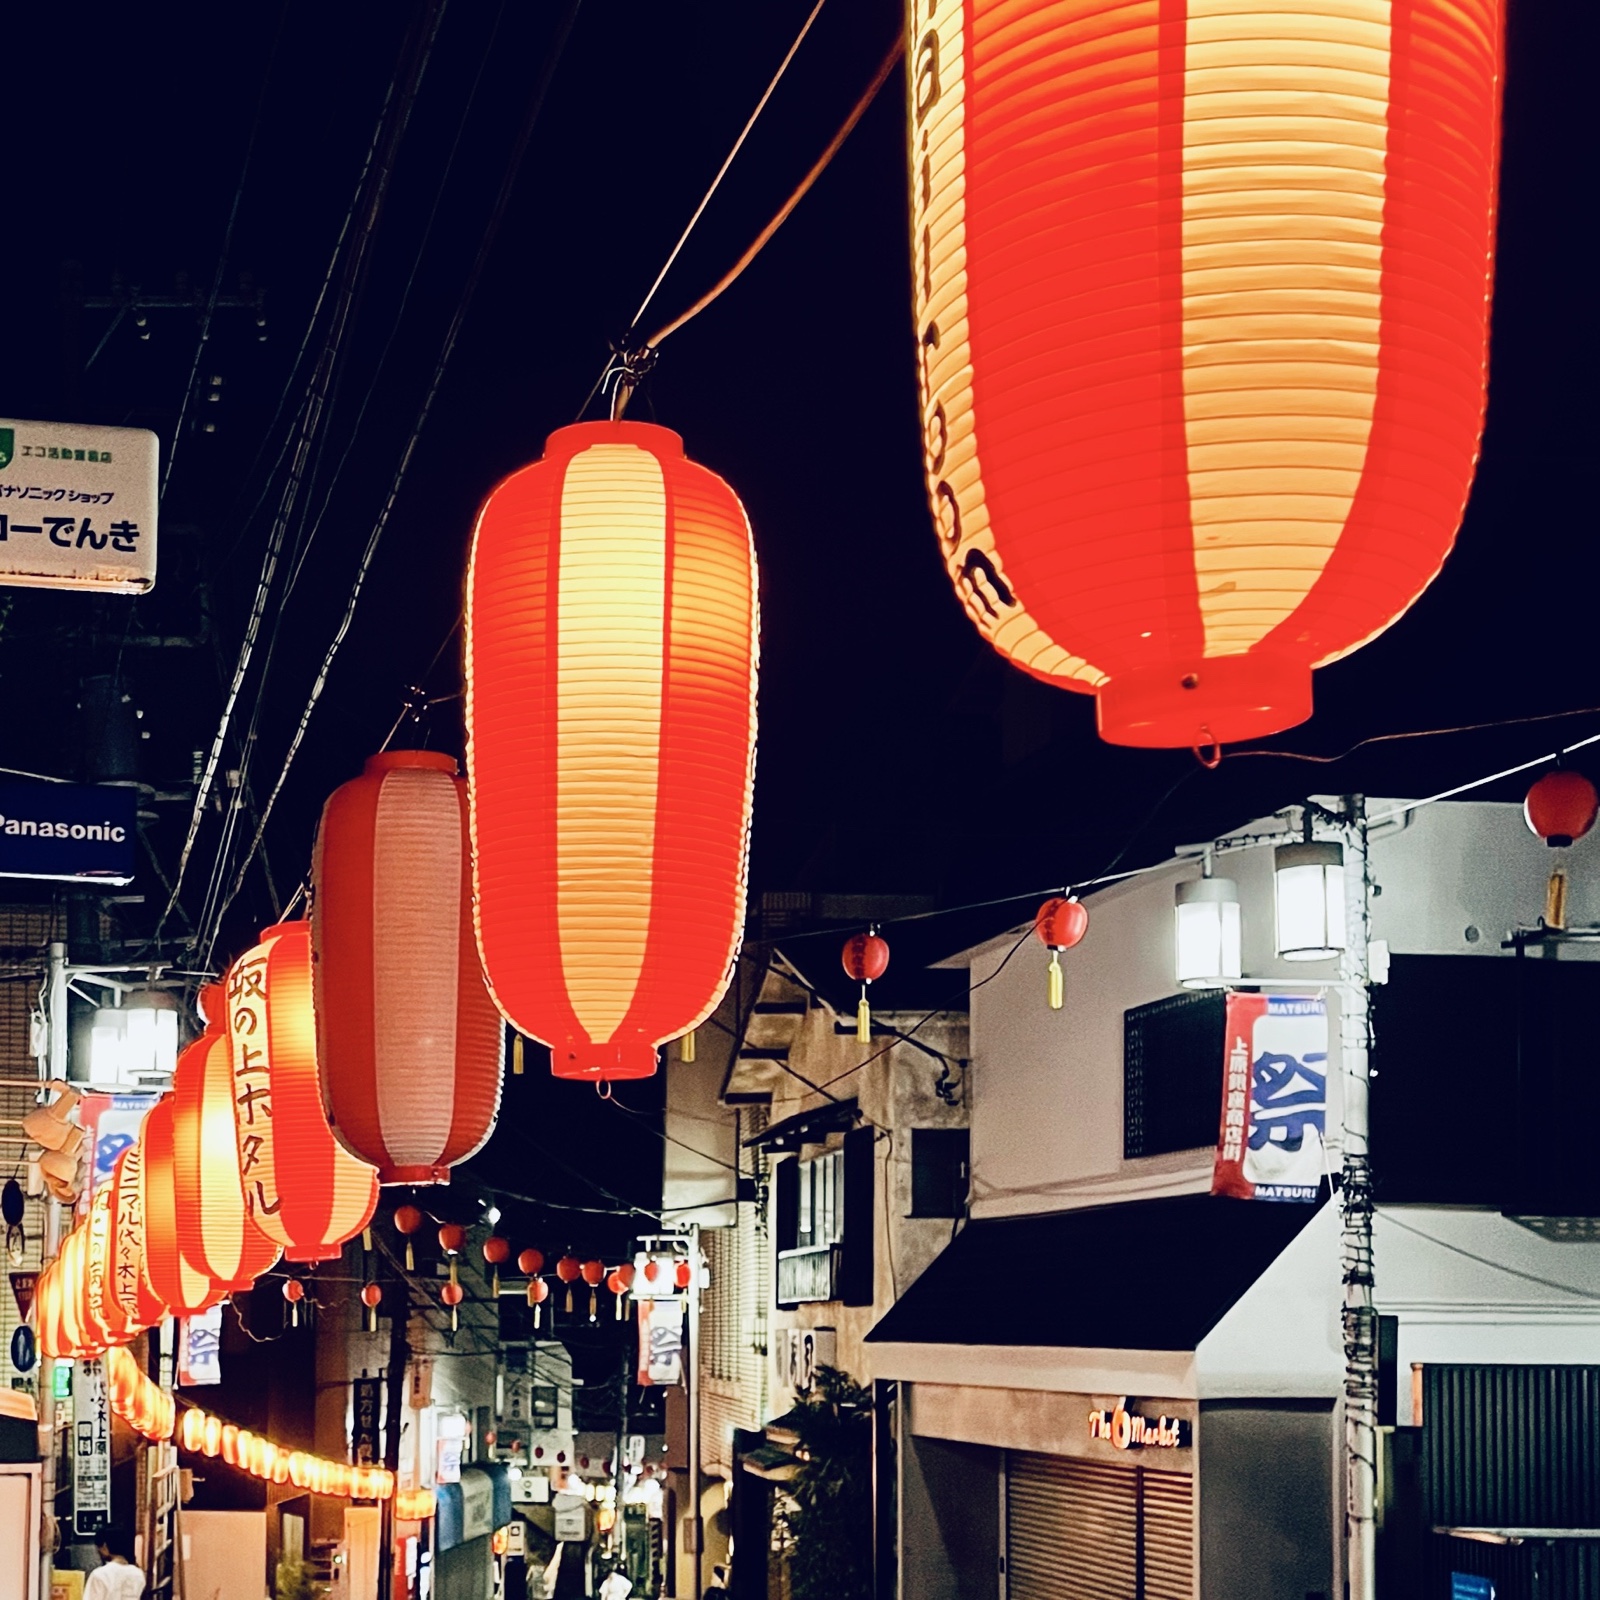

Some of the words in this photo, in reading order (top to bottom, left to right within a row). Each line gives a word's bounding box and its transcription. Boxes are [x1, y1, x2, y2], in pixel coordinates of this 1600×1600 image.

[0, 484, 114, 505] ナソニックショップ
[1267, 1002, 1325, 1016] MATSURI
[1249, 1050, 1327, 1152] 祭
[1254, 1184, 1317, 1199] MATSURI
[1088, 1410, 1111, 1439] The
[1131, 1414, 1180, 1447] Market
